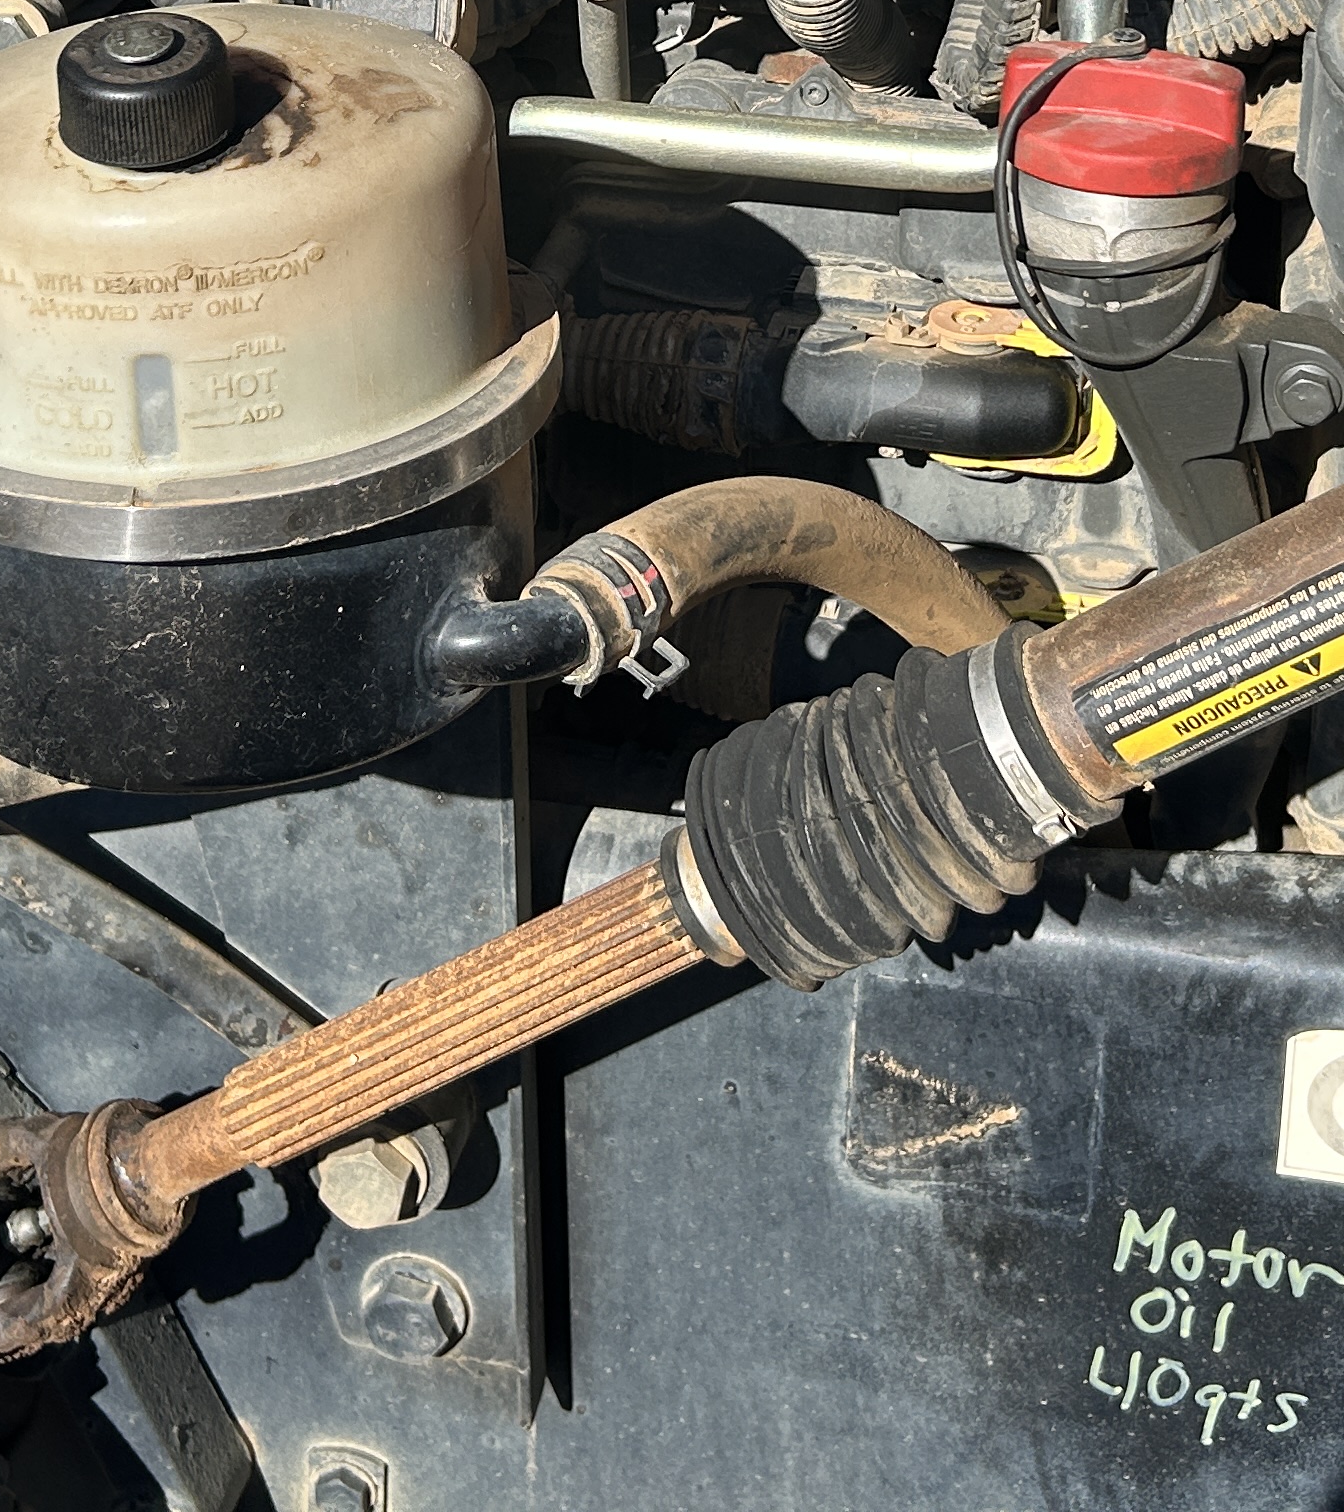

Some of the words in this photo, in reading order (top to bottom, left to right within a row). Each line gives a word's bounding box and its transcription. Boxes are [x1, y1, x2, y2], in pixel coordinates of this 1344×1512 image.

[34, 272, 83, 294] WITH
[27, 299, 139, 322] APPROVED
[150, 302, 194, 321] ATF
[206, 292, 264, 318] ONLY
[230, 336, 286, 360] FULL
[210, 366, 278, 401] HOT
[238, 402, 285, 426] ADD
[1288, 588, 1310, 607] los
[1307, 584, 1318, 597] a
[1215, 596, 1292, 642] componentes
[1298, 605, 1319, 625] de
[1197, 631, 1219, 651] del
[1218, 610, 1302, 662] acoplamiento.
[1278, 634, 1302, 653] con
[1139, 661, 1158, 678] de
[1154, 640, 1201, 672] sistema
[1190, 650, 1223, 676] Falla
[1239, 641, 1282, 673] peligro
[1154, 662, 1194, 693] puede
[1191, 668, 1230, 697] daños.
[1226, 661, 1244, 680] de
[1095, 702, 1114, 719] en
[1111, 681, 1158, 713] resultar
[1155, 685, 1195, 714] Alinear
[1171, 672, 1289, 739] PRECAUCION
[1103, 719, 1121, 736] en
[1117, 702, 1159, 731] flechas
[1130, 1286, 1235, 1354] Oil
